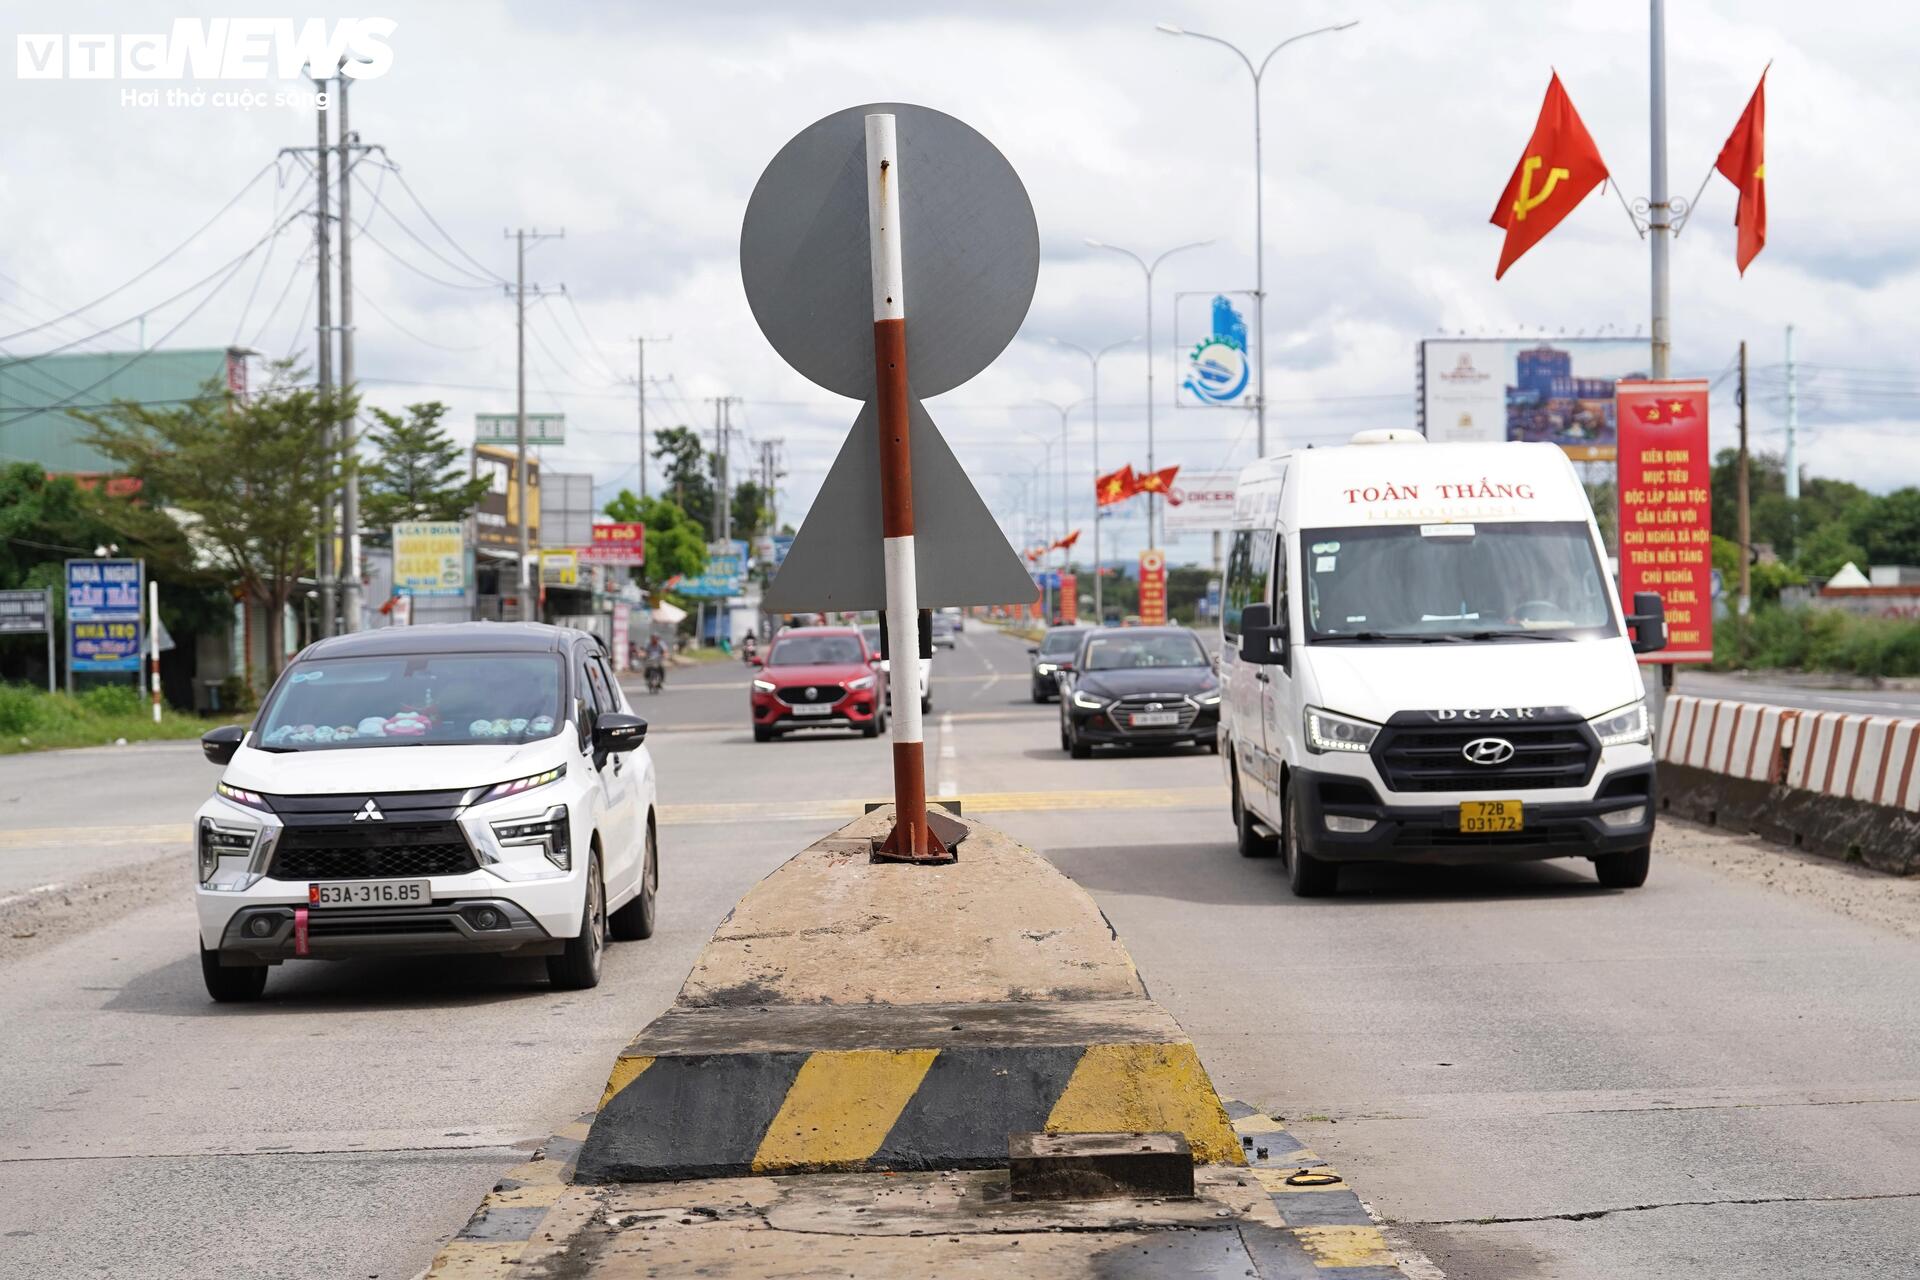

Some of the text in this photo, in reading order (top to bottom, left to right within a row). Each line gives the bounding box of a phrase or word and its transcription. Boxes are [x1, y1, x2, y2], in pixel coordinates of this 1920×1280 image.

[1643, 467, 1689, 487] MỤC TIÊU
[1343, 477, 1535, 504] TOÀN THẮNG
[1624, 488, 1645, 506] ĐỘC
[1666, 487, 1687, 503] DÂN
[1687, 486, 1707, 505] TỘC
[1624, 526, 1645, 544] CHỦ
[1646, 527, 1676, 544] NGHĨA
[1692, 526, 1710, 546] HỘI
[1641, 567, 1694, 584] CHỦ NGHĨA
[1438, 706, 1534, 720] DCAR
[1478, 802, 1504, 816] 72B
[1467, 816, 1516, 831] 031.72
[320, 884, 420, 903] 63A-316.85
